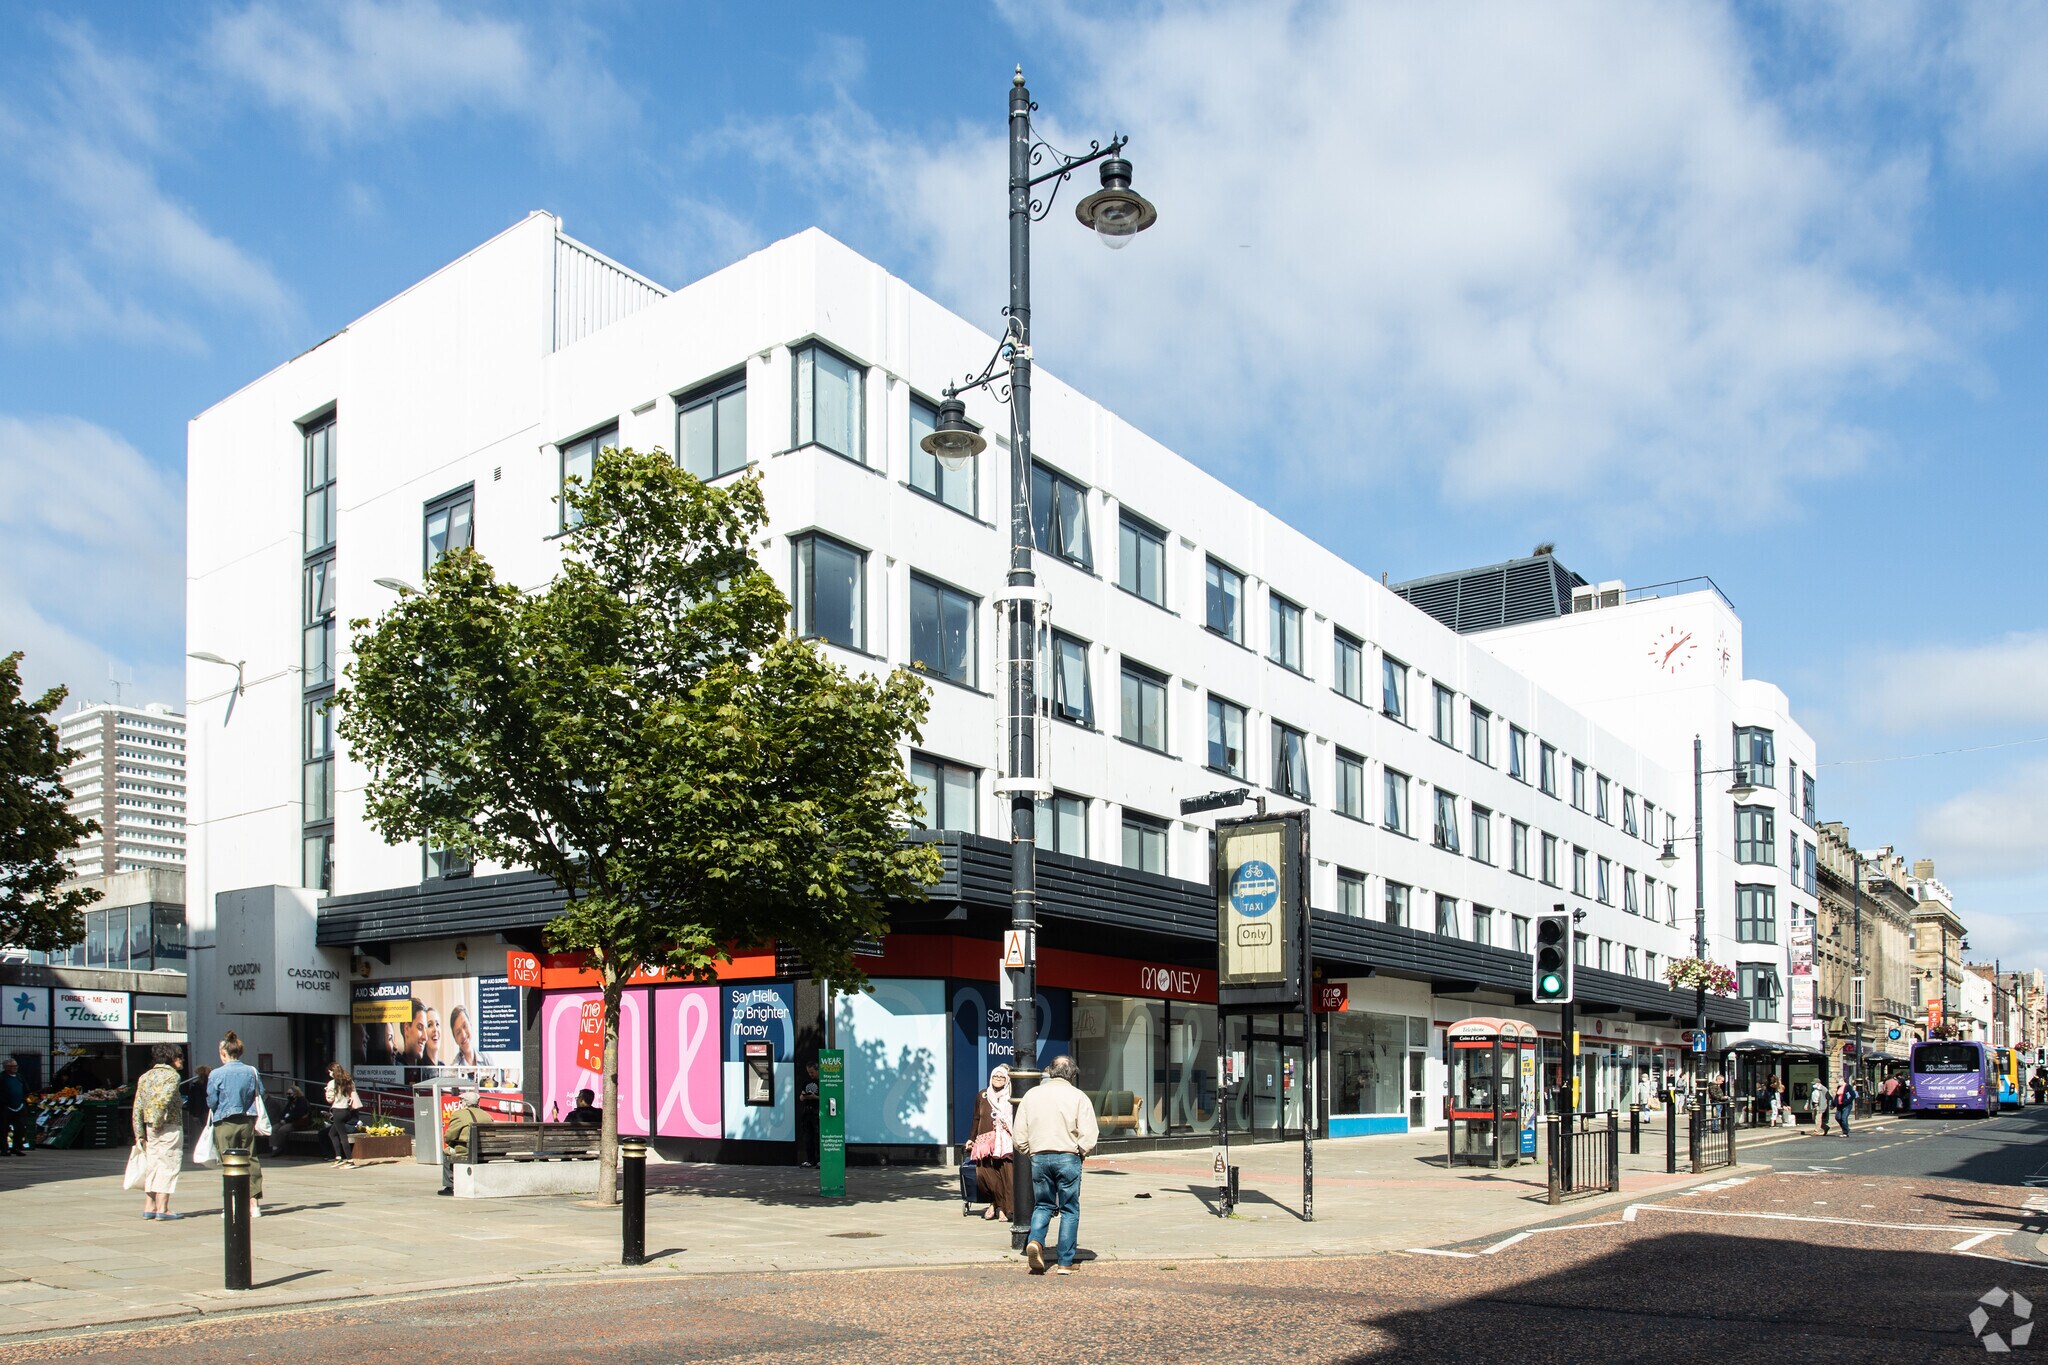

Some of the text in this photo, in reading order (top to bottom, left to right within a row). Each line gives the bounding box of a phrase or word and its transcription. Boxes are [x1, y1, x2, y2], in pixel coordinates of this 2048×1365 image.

[1243, 902, 1264, 912] TAXI
[1242, 929, 1267, 940] Only
[228, 963, 261, 977] CASSATON
[287, 968, 340, 980] CASSATON
[233, 979, 256, 991] HOUSE
[296, 981, 331, 991] HOUSE
[1141, 966, 1201, 994] MONEY
[355, 985, 410, 998] AXO SUNDERLAND
[732, 989, 779, 1006] Say Hello
[60, 994, 85, 1003] FORGET
[732, 1005, 790, 1022] to Brighter
[987, 1009, 1005, 1026] Say
[733, 1022, 768, 1039] Money
[987, 1026, 999, 1039] to
[988, 1041, 1015, 1056] Mone
[820, 1057, 842, 1065] WEAR
[1925, 1064, 1934, 1072] 20
